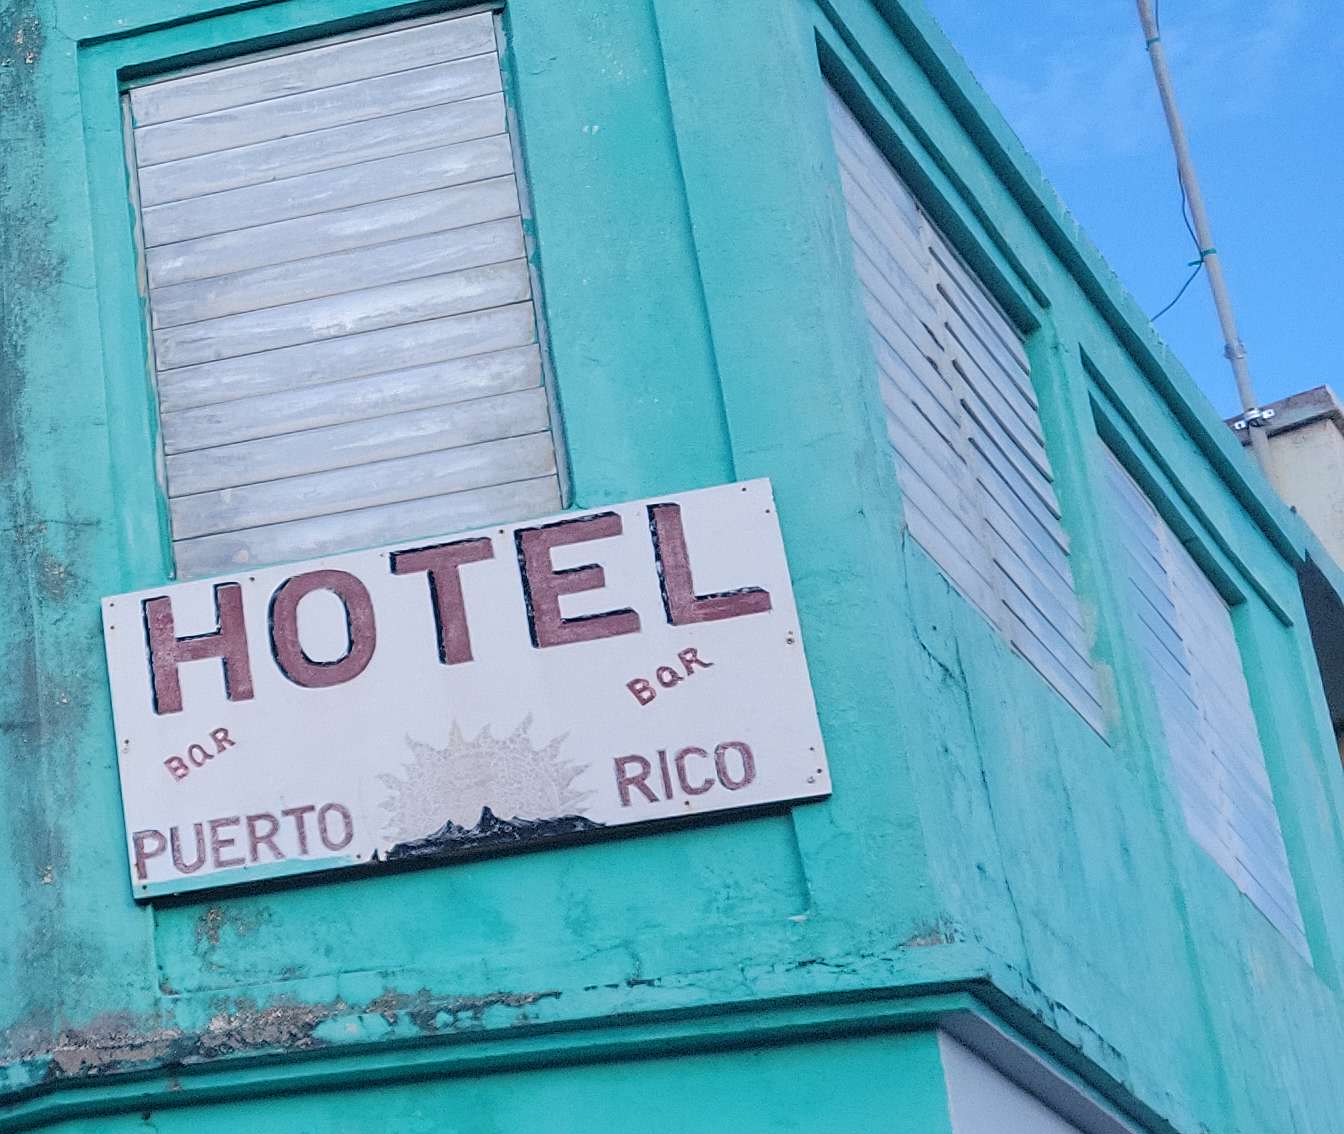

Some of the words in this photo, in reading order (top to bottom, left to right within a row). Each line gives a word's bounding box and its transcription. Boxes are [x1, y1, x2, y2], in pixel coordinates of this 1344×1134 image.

[141, 501, 773, 716] HOTEL
[131, 802, 355, 881] PUERTO
[612, 740, 757, 807] RICO
